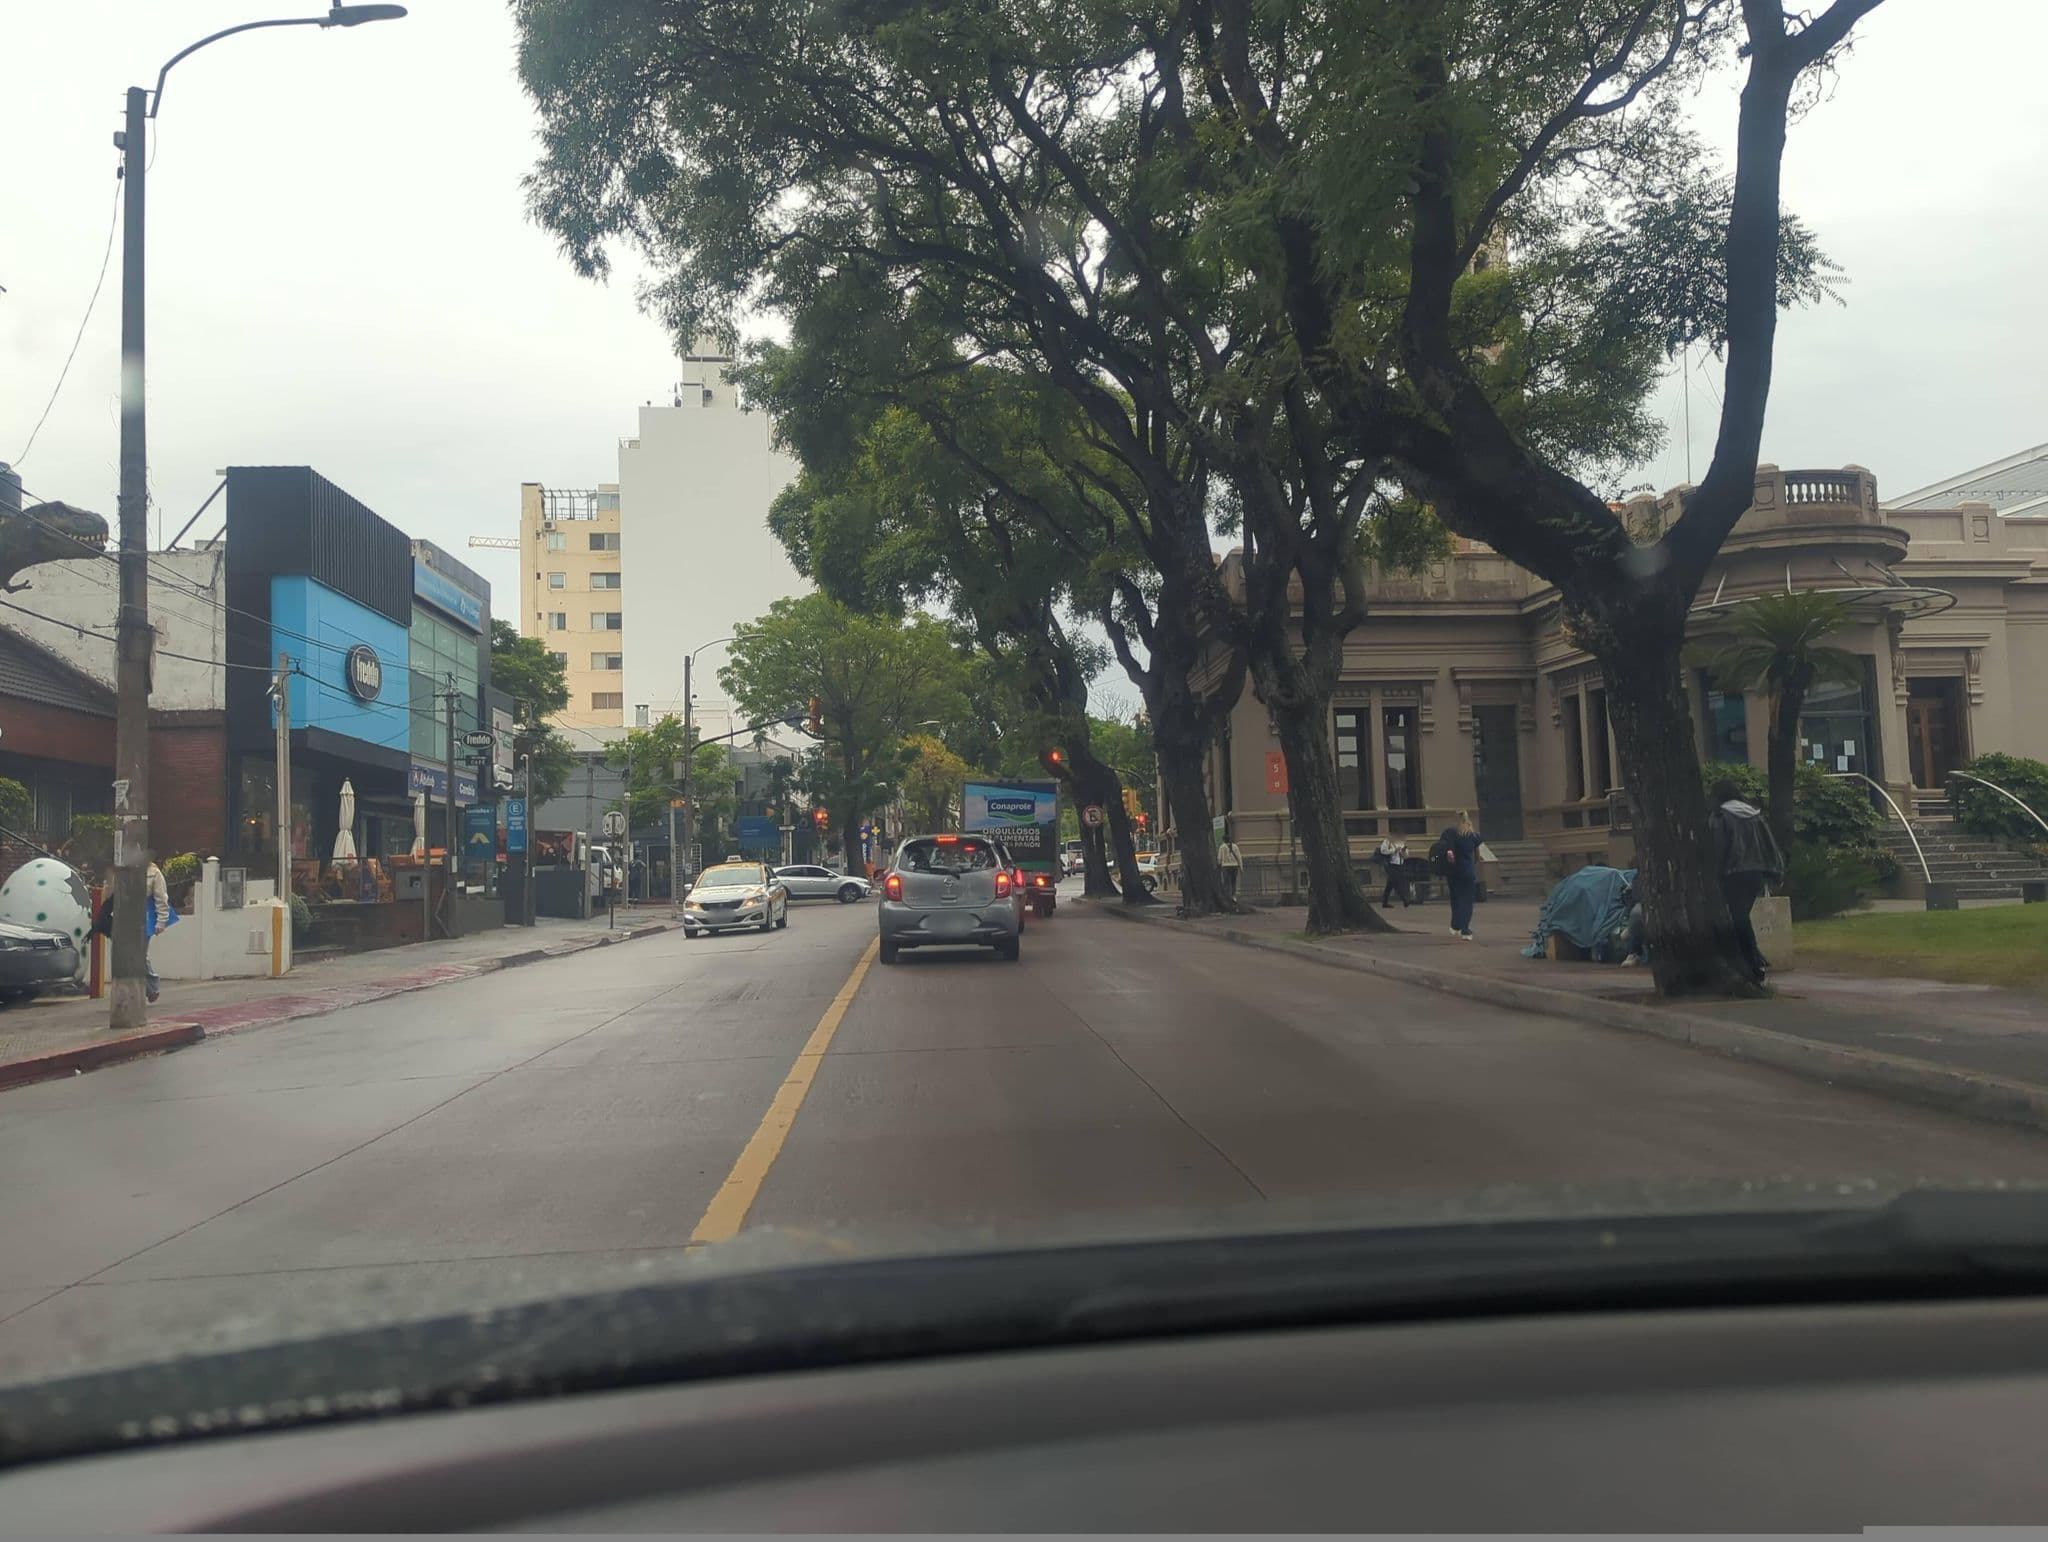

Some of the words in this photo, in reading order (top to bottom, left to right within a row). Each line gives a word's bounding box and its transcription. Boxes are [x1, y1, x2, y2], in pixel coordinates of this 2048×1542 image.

[357, 655, 379, 688] freddo
[466, 734, 490, 745] freddo
[990, 802, 1032, 811] Conaprole
